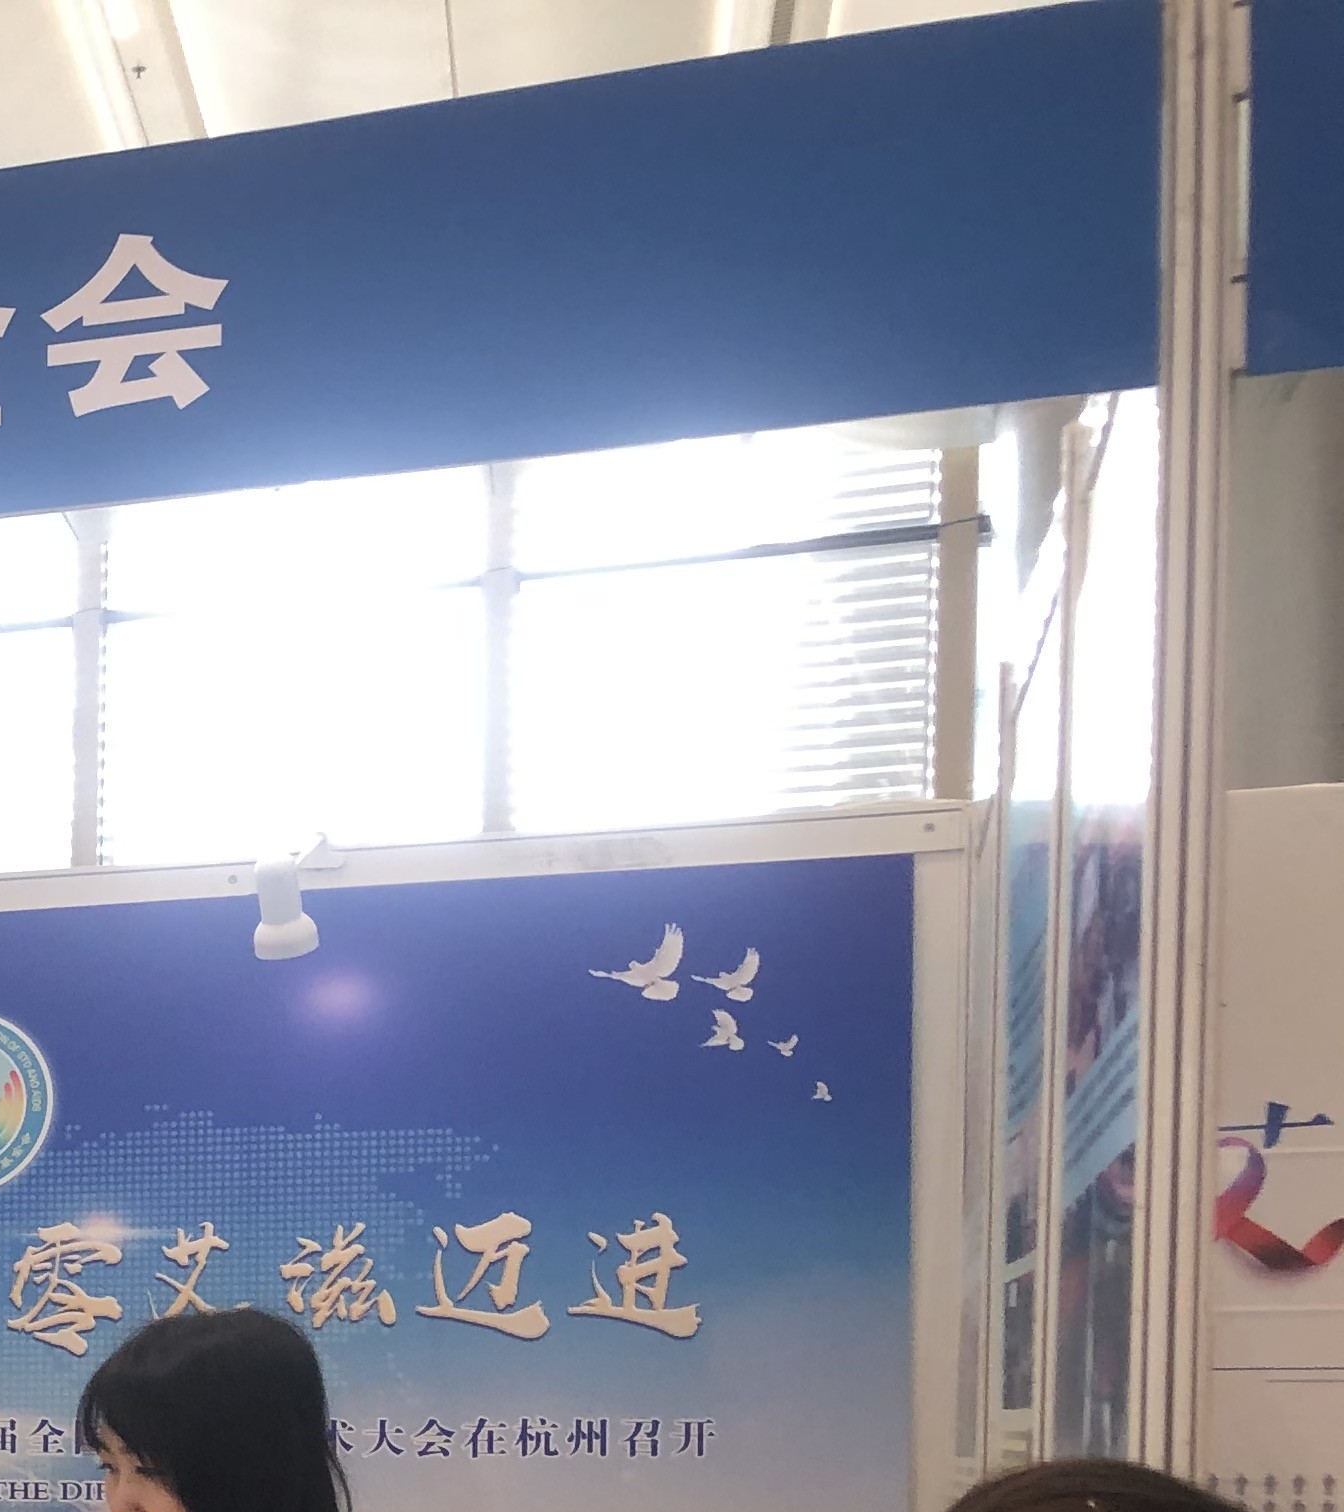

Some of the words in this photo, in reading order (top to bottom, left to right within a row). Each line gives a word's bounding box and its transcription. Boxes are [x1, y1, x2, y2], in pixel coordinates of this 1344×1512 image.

[325, 1416, 716, 1459] 术大会在杭州召开
